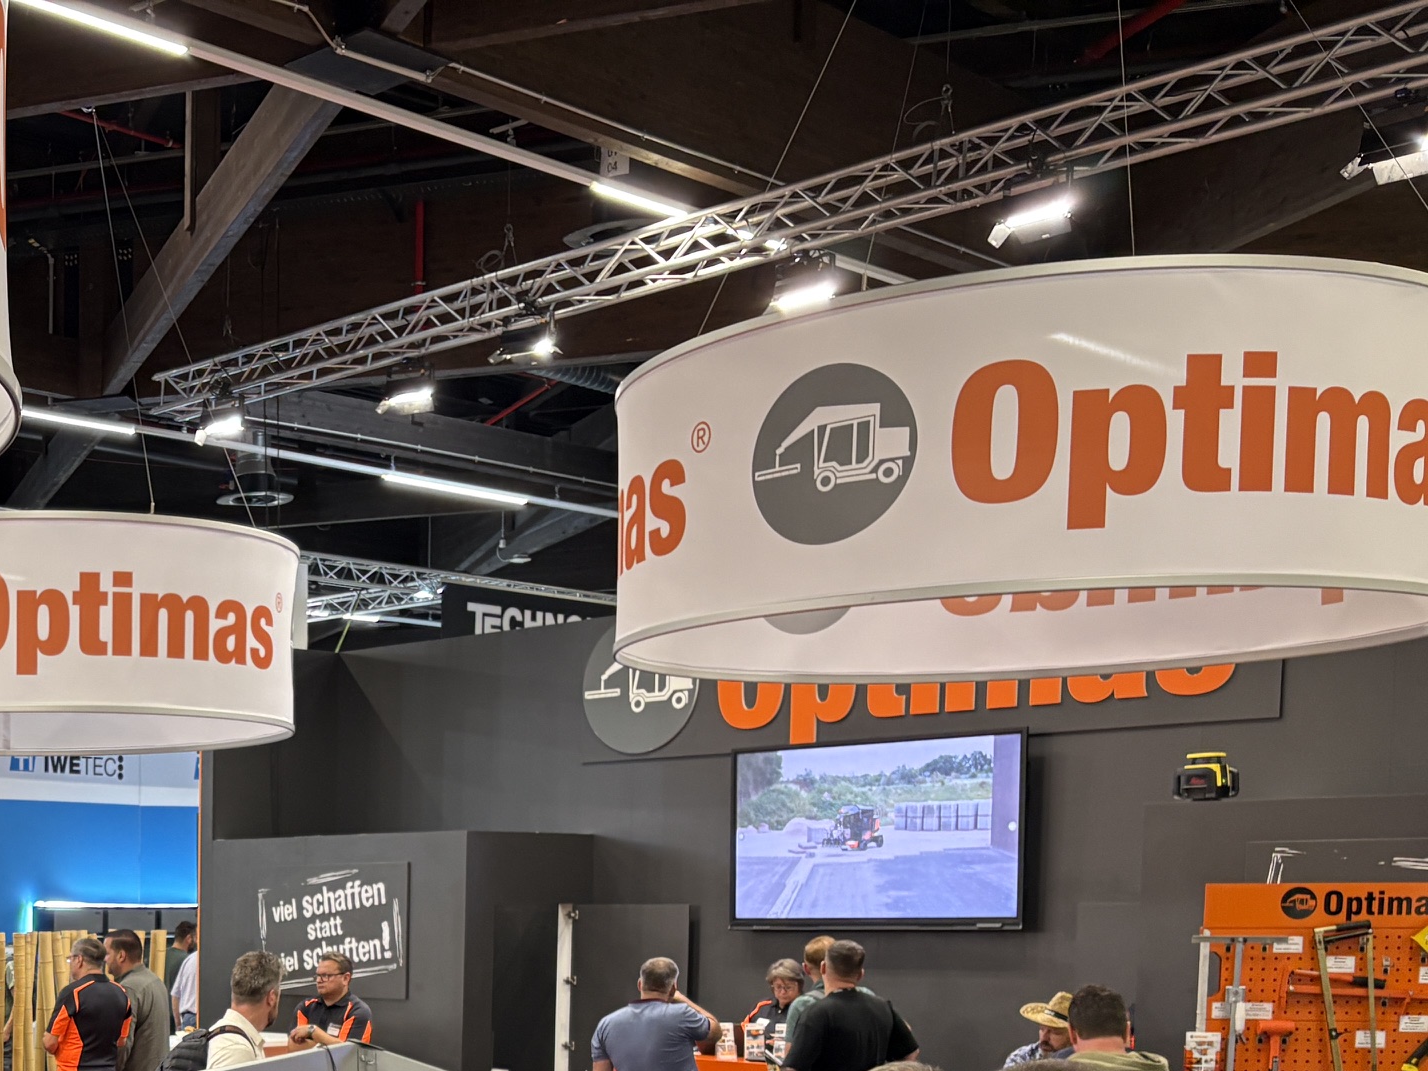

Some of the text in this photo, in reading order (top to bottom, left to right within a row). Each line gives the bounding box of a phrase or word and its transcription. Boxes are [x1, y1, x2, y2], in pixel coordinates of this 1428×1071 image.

[44, 756, 118, 779] IWETEC
[272, 879, 386, 923] viel schaffen
[307, 915, 343, 941] statt
